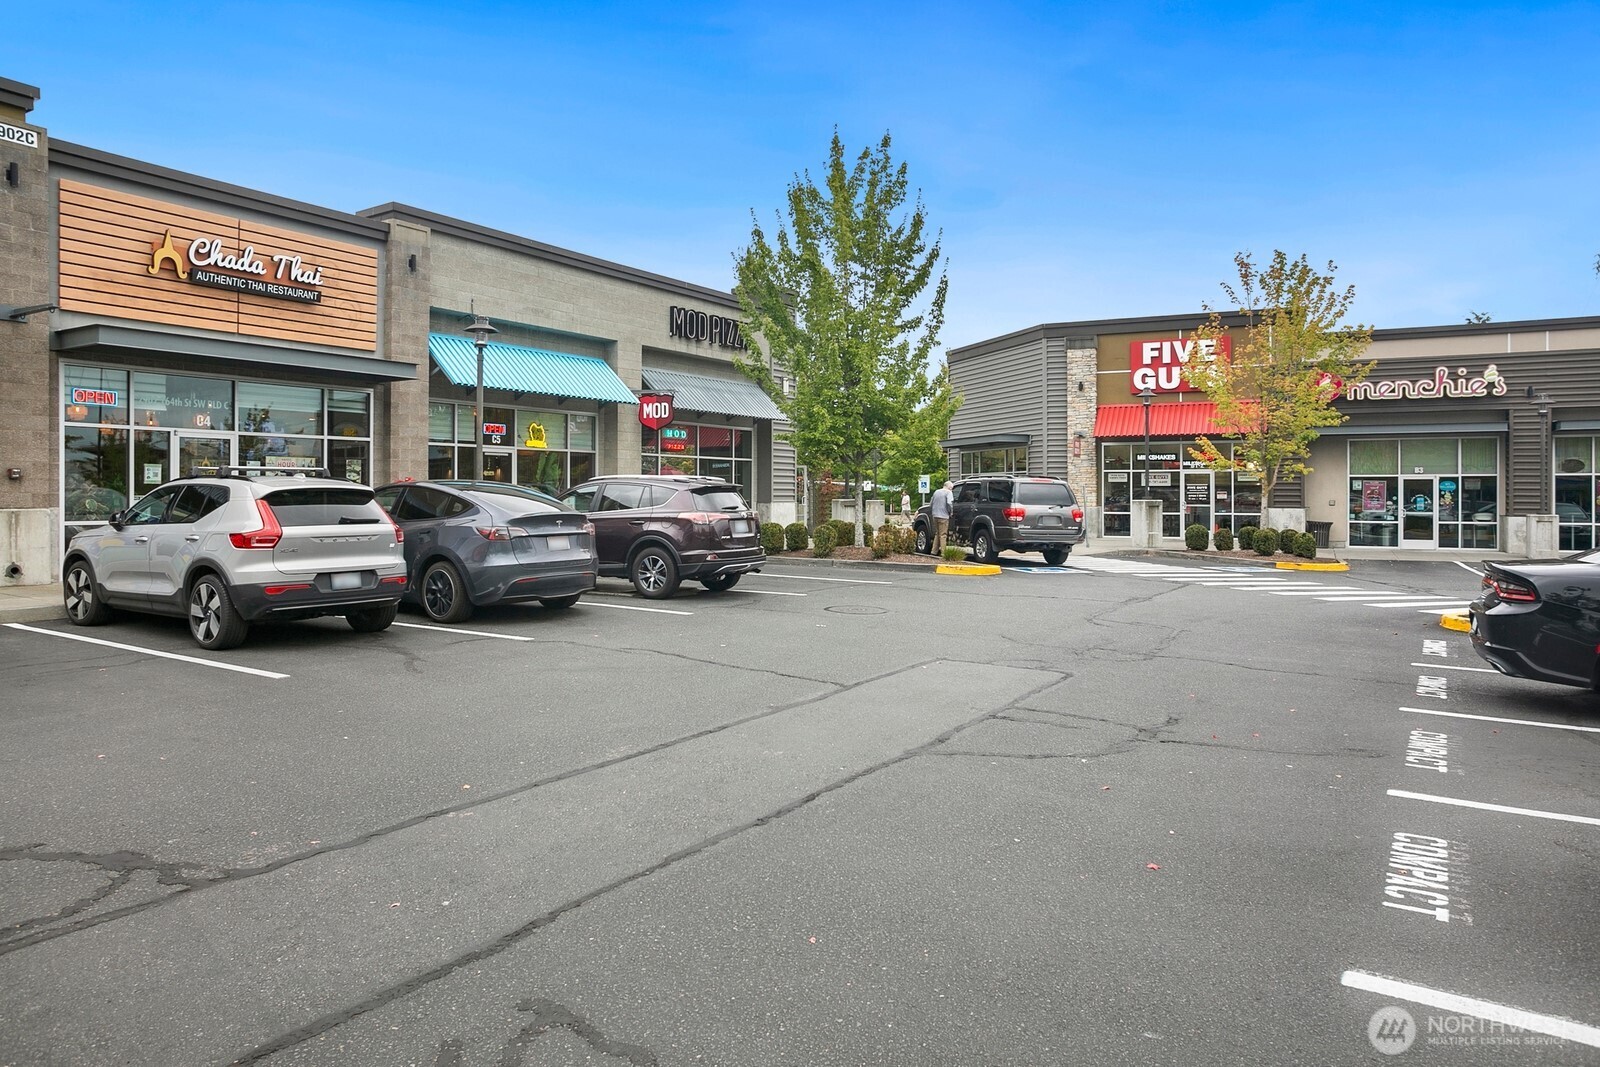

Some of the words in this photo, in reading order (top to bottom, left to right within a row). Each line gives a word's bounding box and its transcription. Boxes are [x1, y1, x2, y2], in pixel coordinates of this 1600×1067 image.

[189, 238, 267, 275] Chada
[273, 254, 324, 286] Thai
[196, 271, 246, 289] AUTHENTIC
[247, 280, 266, 292] THAI
[267, 284, 318, 300] RESTAURANT
[669, 305, 707, 341] MOD
[708, 314, 748, 351] PIZZ
[1142, 339, 1217, 365] FIVE
[74, 390, 115, 405] OPEN
[193, 399, 206, 409] SW
[642, 402, 670, 419] MOD
[485, 424, 504, 434] OPEN
[491, 434, 502, 444] C5
[1405, 730, 1448, 773] COMPACT
[1382, 832, 1449, 923] COMPACT
